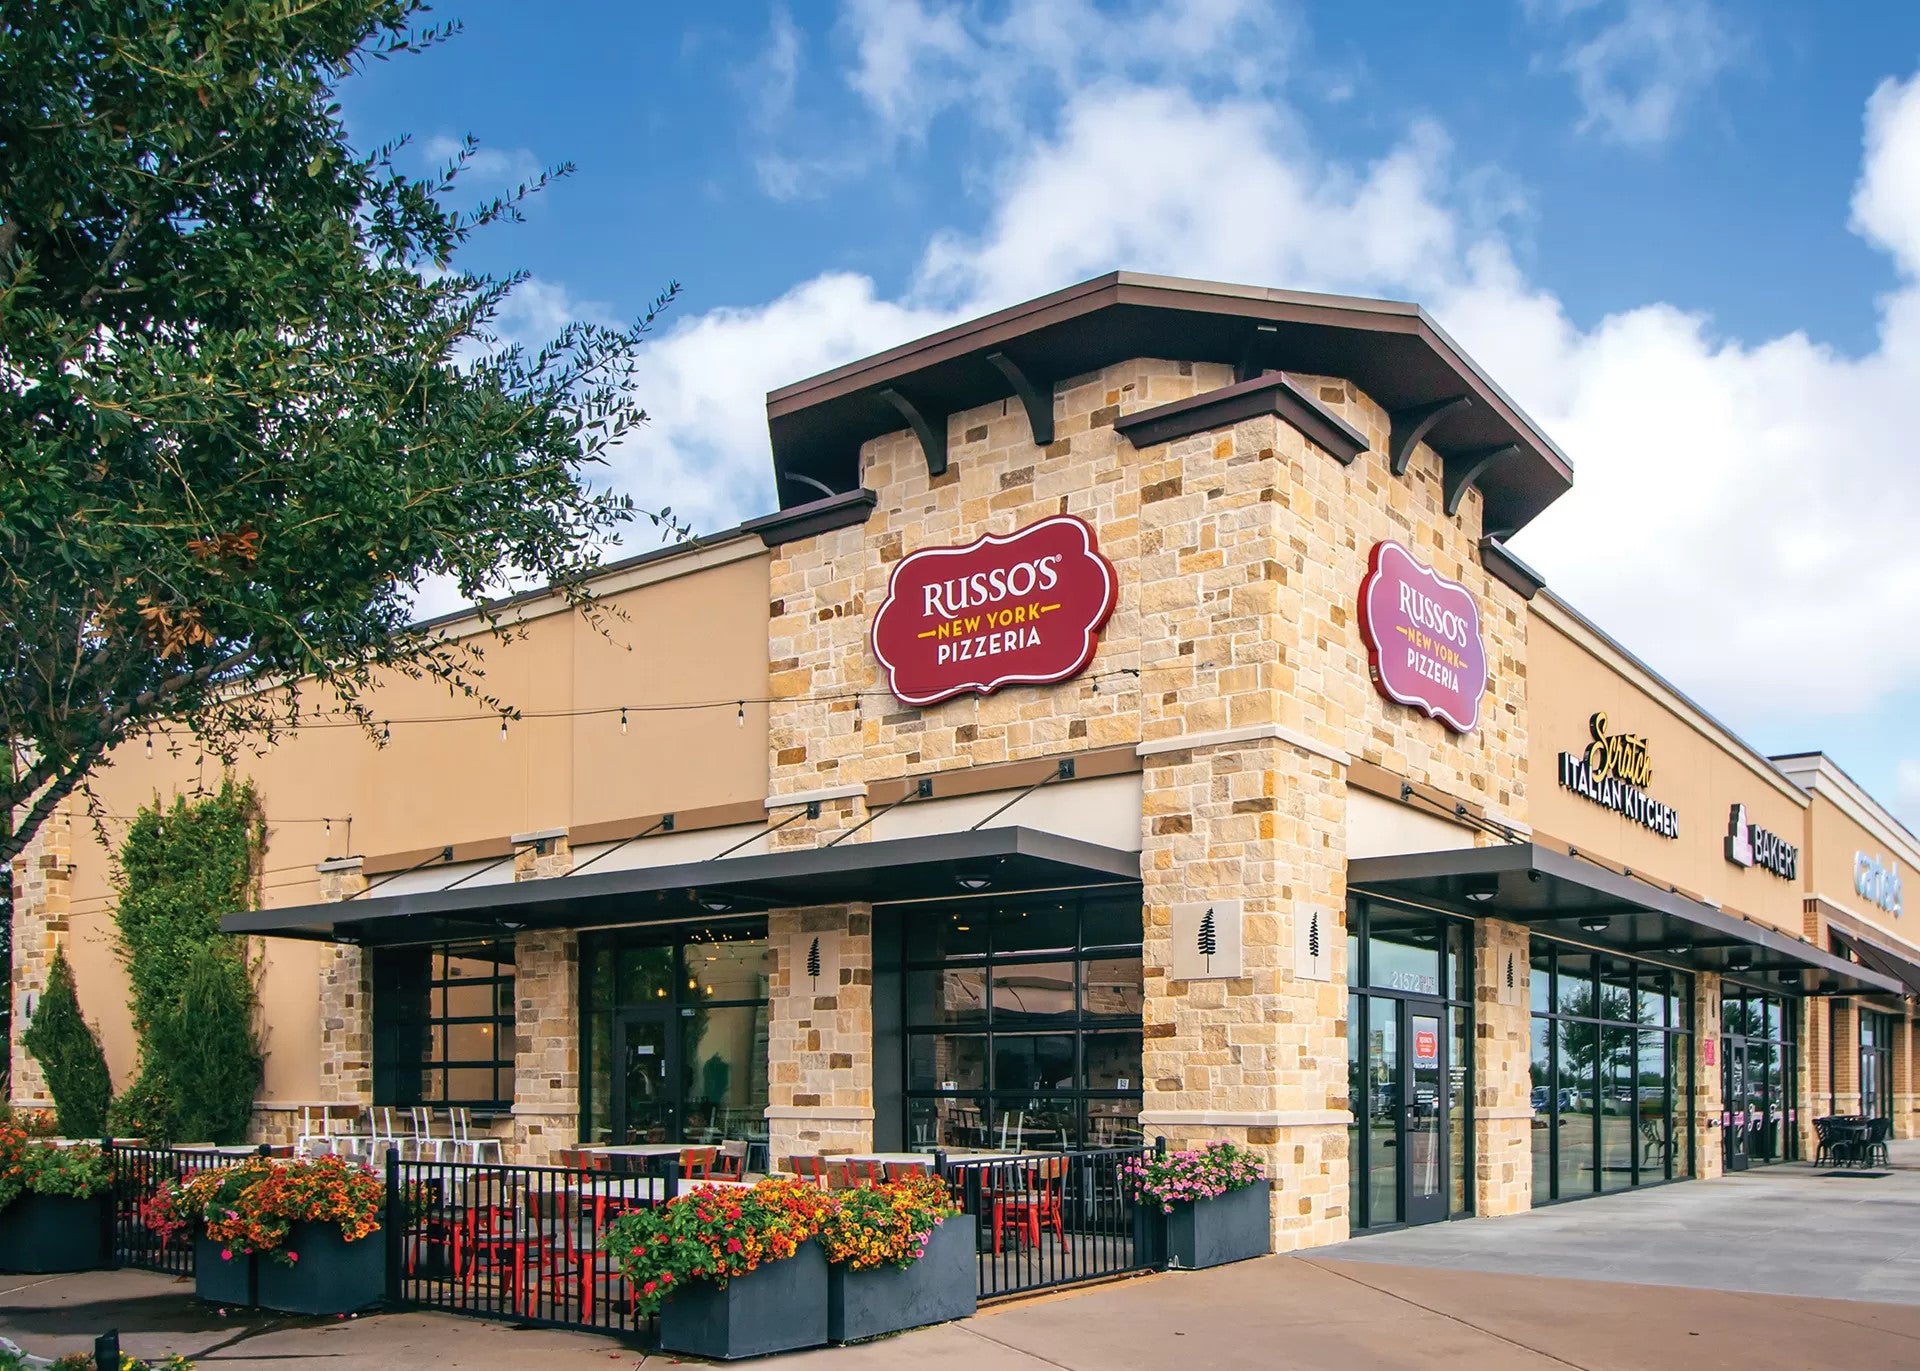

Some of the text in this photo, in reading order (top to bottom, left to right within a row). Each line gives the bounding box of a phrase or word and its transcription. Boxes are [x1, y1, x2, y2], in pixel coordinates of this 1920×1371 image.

[937, 602, 1040, 640] NEW YORK
[938, 626, 1041, 665] PIZZERIA
[1406, 626, 1460, 669] NEW YORK
[1407, 648, 1459, 693] PIZZERIA
[1563, 752, 1679, 838] ITALIAN KITCHEN
[1753, 824, 1798, 880] BAKERY
